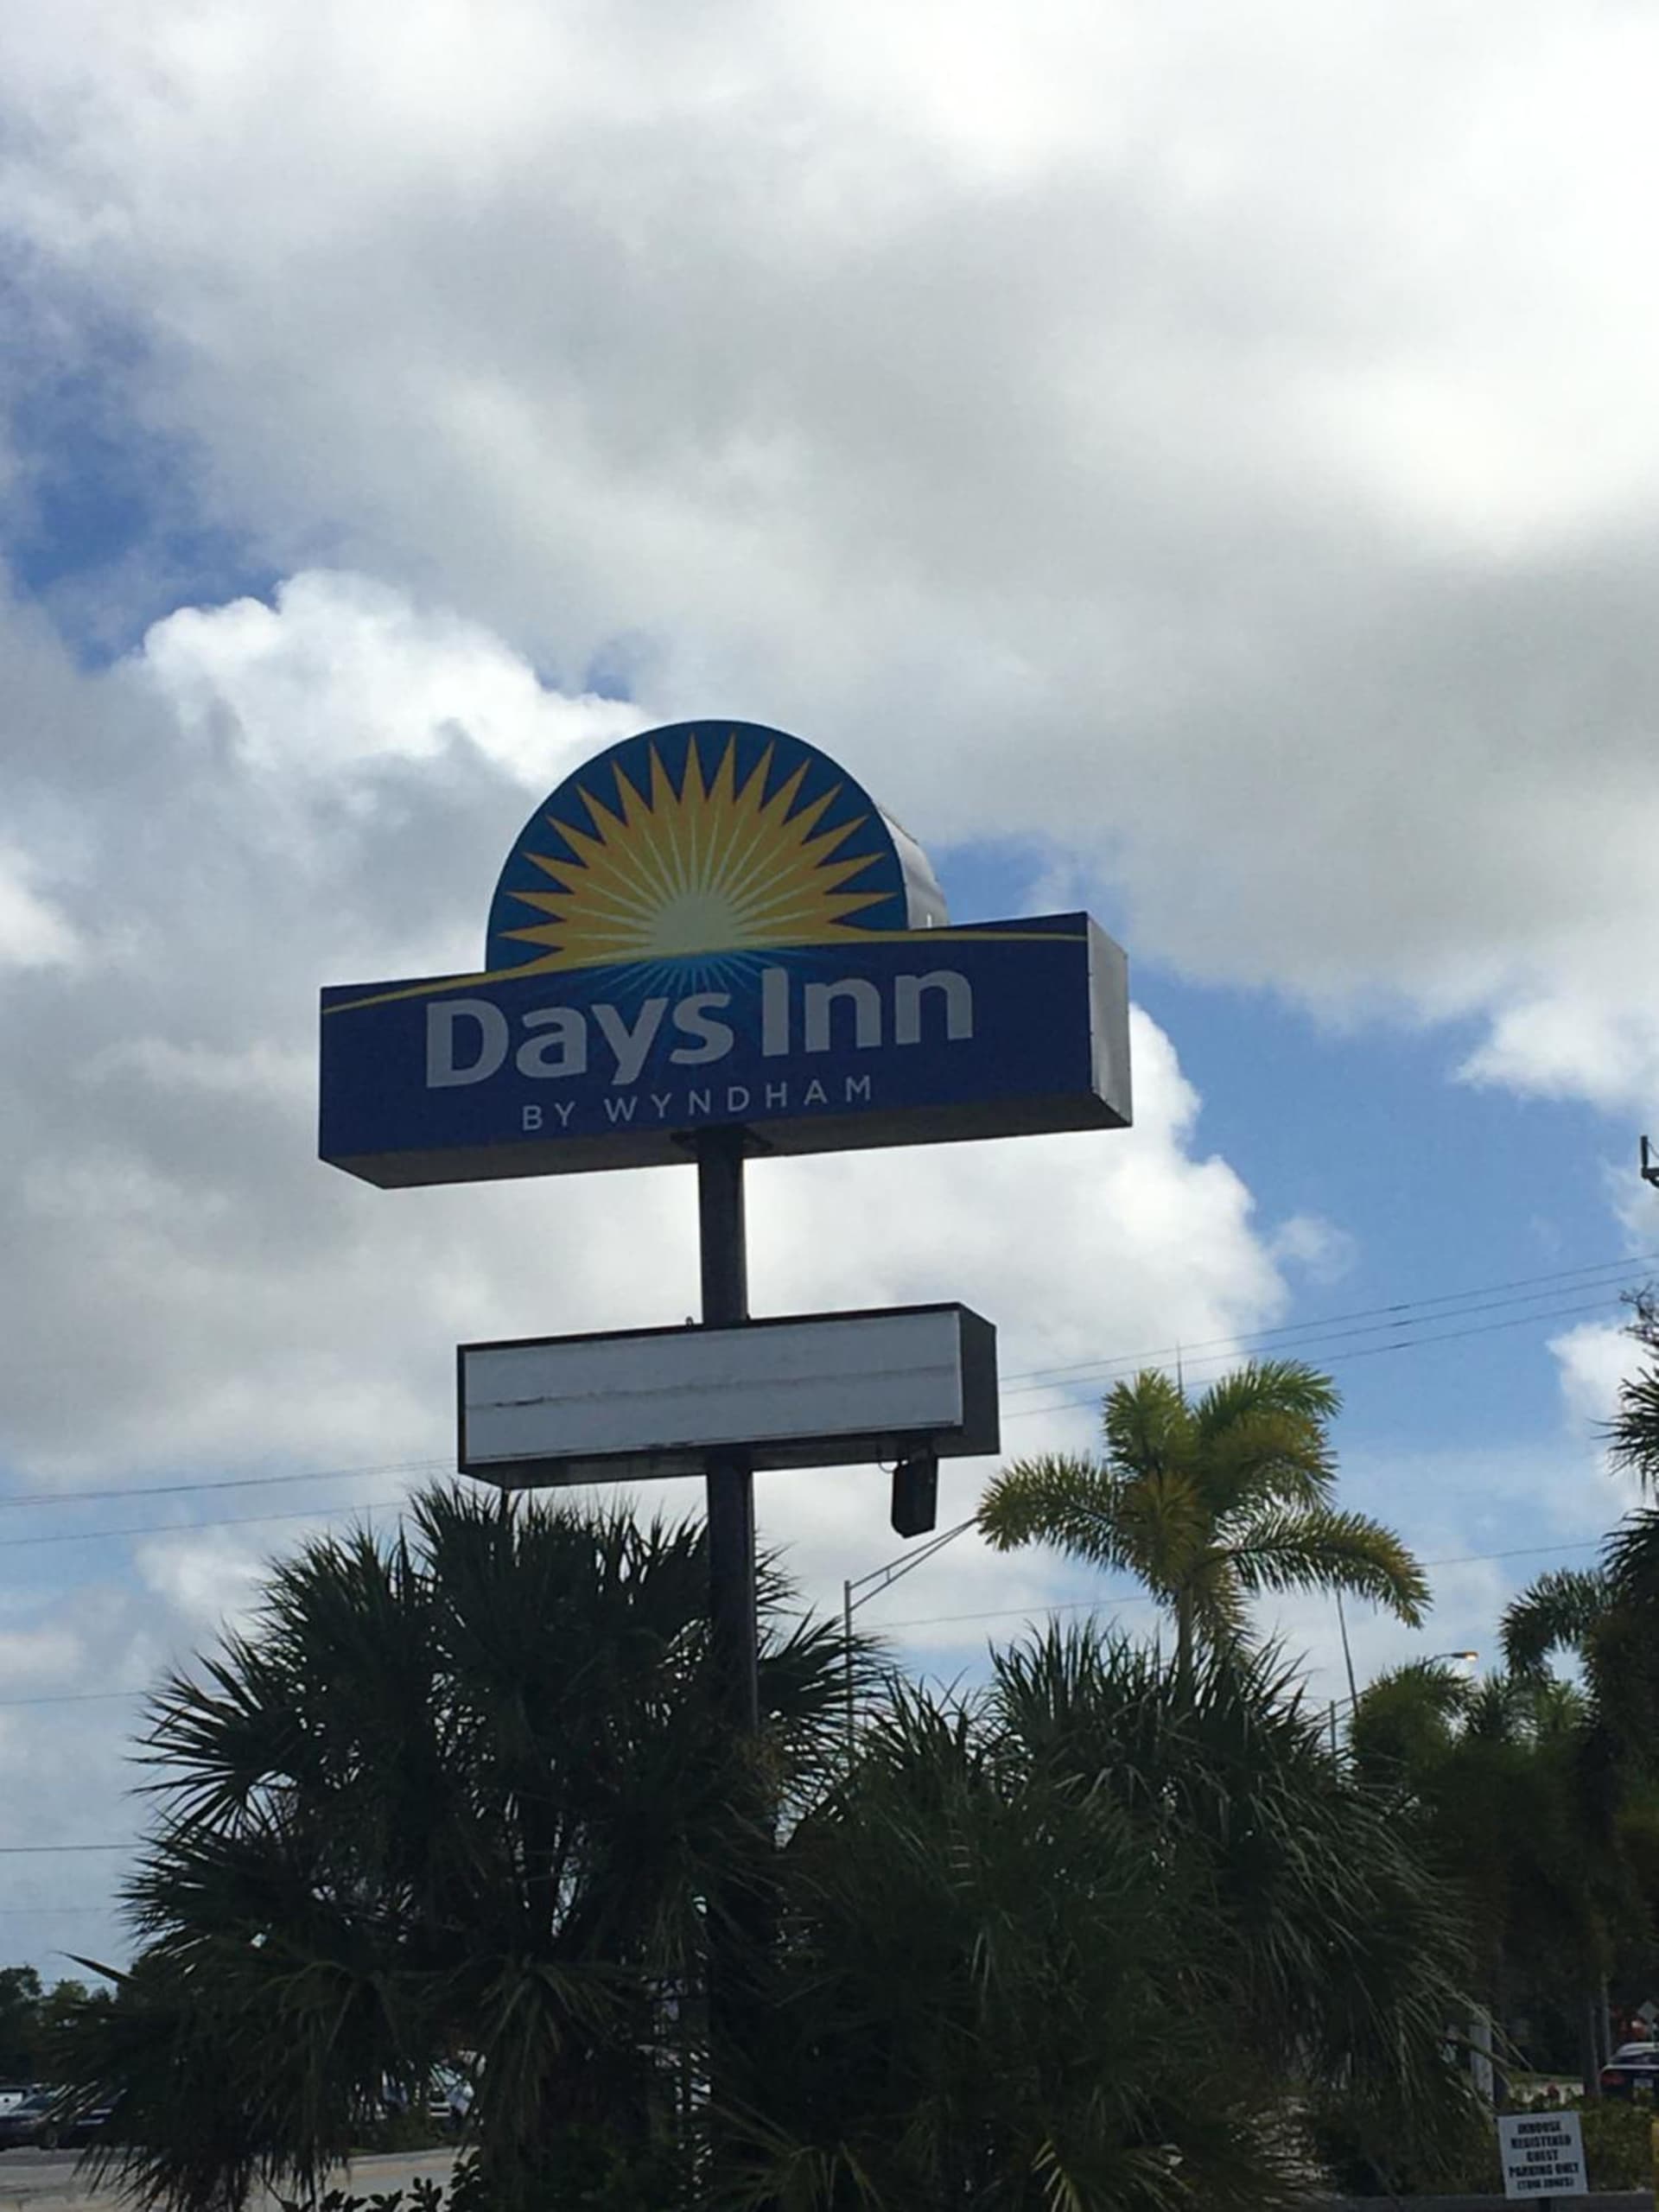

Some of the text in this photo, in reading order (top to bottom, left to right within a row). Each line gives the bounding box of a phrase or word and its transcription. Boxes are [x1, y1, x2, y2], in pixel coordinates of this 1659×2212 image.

[426, 967, 973, 1089] Days Inn
[522, 1075, 871, 1131] BY WYNDHAM
[1510, 2134, 1572, 2149] REGISTERED
[1526, 2149, 1558, 2162] GUEST
[1508, 2162, 1579, 2177] PARKING ONLY
